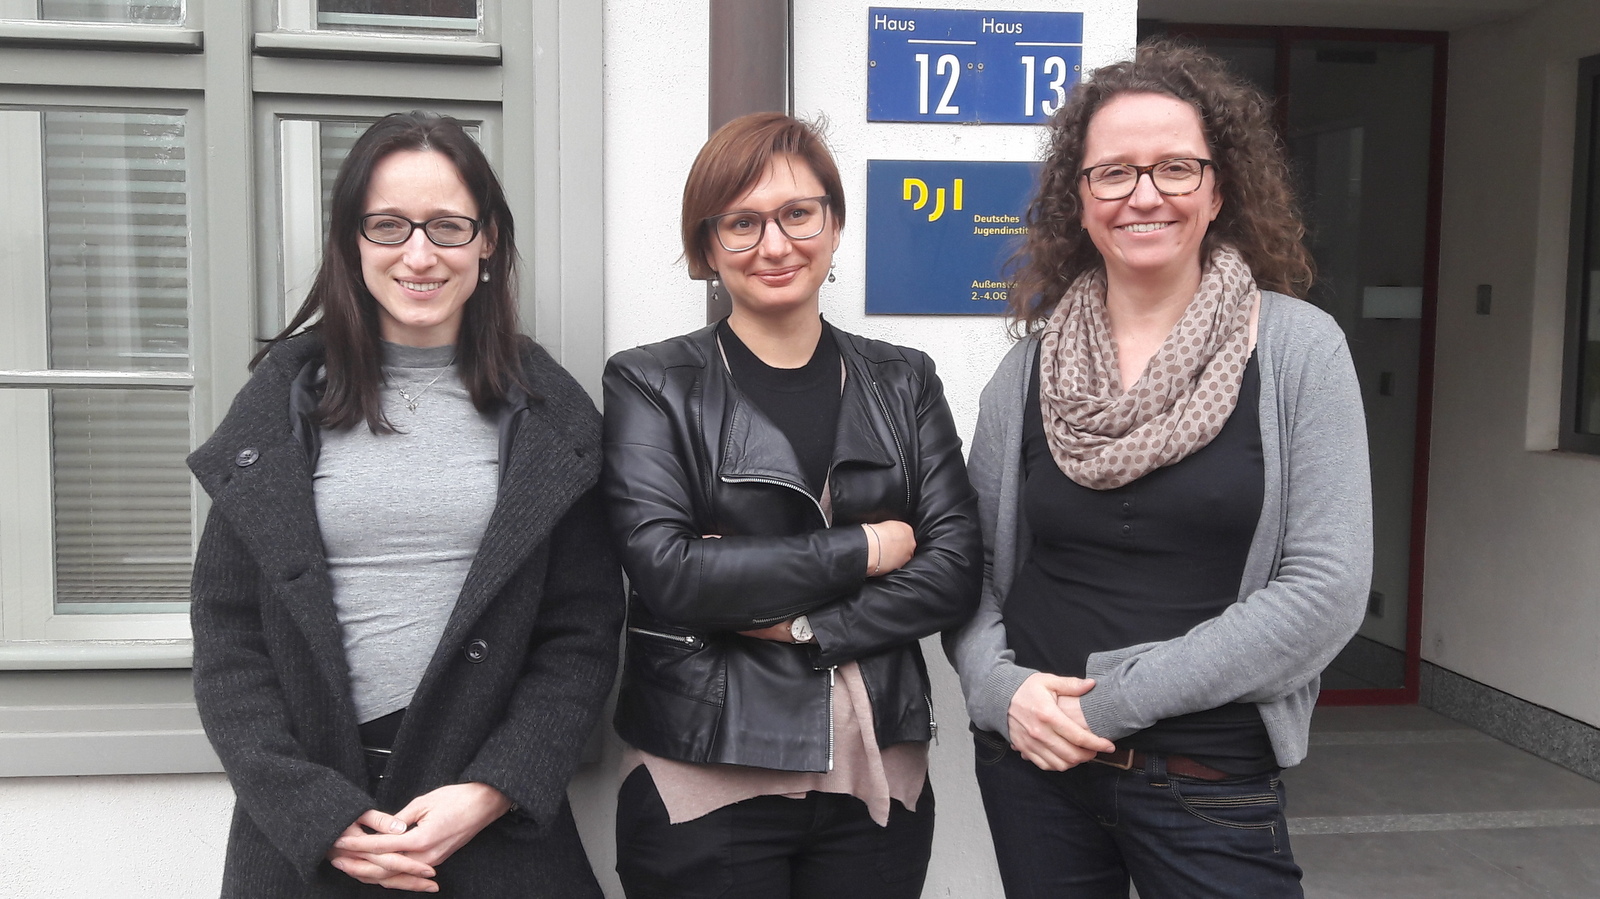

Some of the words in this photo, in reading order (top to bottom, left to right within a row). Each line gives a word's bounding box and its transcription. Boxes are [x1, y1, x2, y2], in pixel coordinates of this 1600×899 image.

[874, 14, 916, 32] Haus
[982, 17, 1023, 34] Haus
[915, 53, 961, 115] 12
[1021, 55, 1067, 117] 13
[903, 178, 963, 222] DJI
[973, 214, 1020, 223] Deutsches
[973, 226, 1029, 237] Jugendinstit
